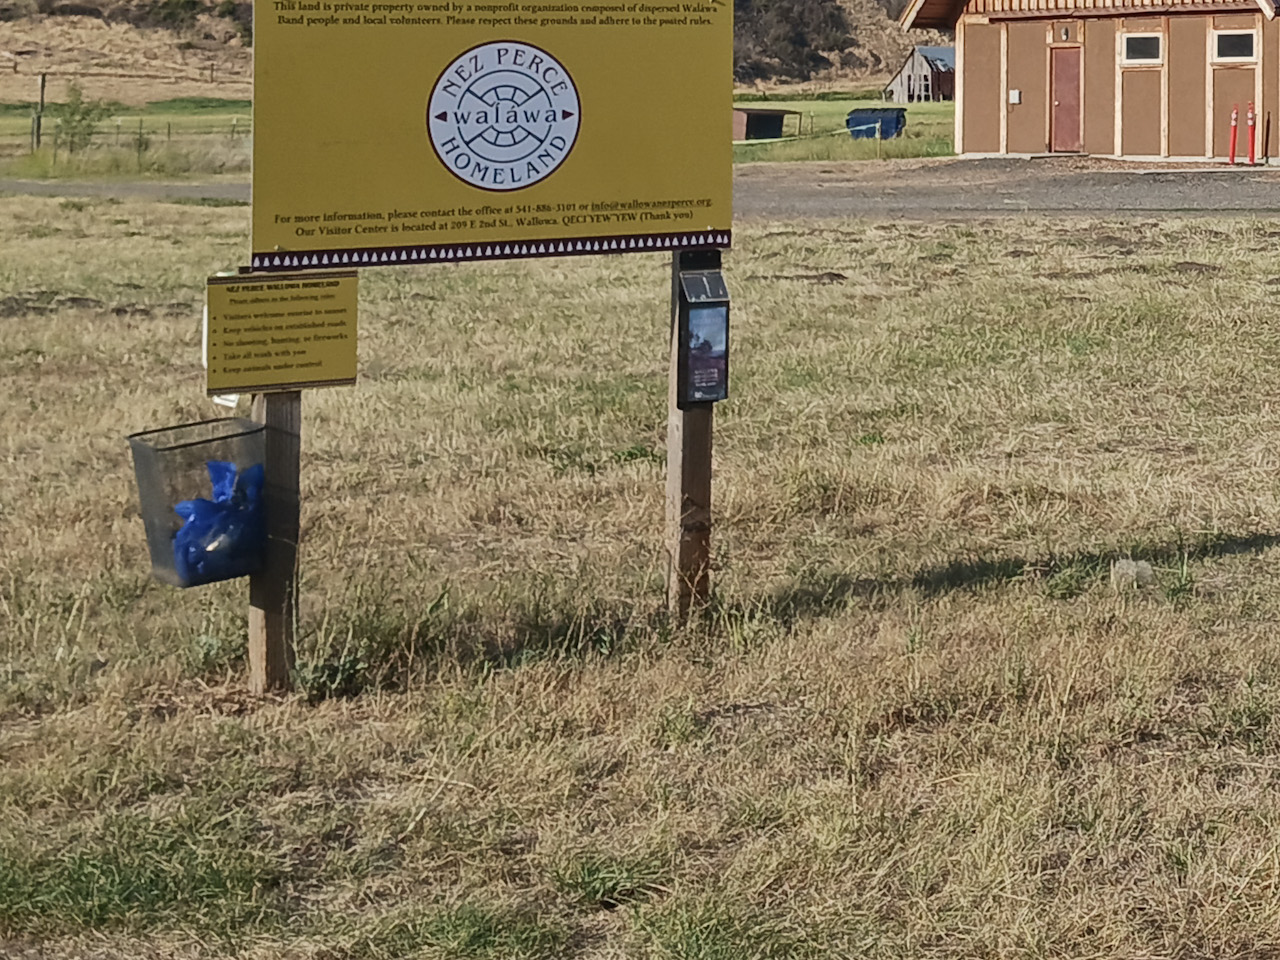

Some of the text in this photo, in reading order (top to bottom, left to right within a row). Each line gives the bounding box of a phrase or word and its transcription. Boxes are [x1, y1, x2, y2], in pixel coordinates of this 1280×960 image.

[273, 2, 295, 11] This
[298, 2, 320, 11] land
[323, 3, 331, 11] is
[334, 2, 369, 14] private
[372, 3, 414, 14] property
[417, 3, 450, 12] owned
[453, 2, 463, 14] by
[466, 4, 472, 12] a
[474, 3, 519, 15] nonprofit
[522, 4, 578, 14] organization
[581, 4, 625, 15] composed
[628, 4, 637, 12] of
[639, 4, 679, 14] dispersed
[278, 15, 304, 25] Band
[307, 16, 339, 26] people
[343, 15, 360, 25] and
[363, 16, 386, 25] local
[447, 16, 475, 25] Please
[478, 16, 511, 28] respect
[514, 17, 538, 26] these
[541, 17, 578, 27] grounds
[581, 16, 596, 25] and
[599, 16, 629, 26] adhere
[632, 17, 641, 26] to
[644, 16, 657, 26] the
[659, 17, 687, 27] posted
[442, 48, 568, 97] NEZ PERCE
[440, 135, 567, 184] HOMELAND
[274, 215, 291, 224] For
[294, 214, 320, 222] more
[324, 212, 385, 222] information,
[388, 210, 417, 222] please
[420, 209, 455, 218] contact
[458, 208, 472, 216] the
[475, 206, 502, 216] office
[505, 206, 513, 214] at
[295, 227, 315, 236] Our
[318, 226, 352, 236] Visitor
[355, 224, 388, 234] Center
[391, 223, 399, 233] is
[402, 221, 436, 232] located
[439, 221, 448, 230] at
[470, 220, 477, 228] E
[479, 219, 496, 228] 2nd
[640, 211, 671, 221] (Thank
[673, 210, 694, 221] you)
